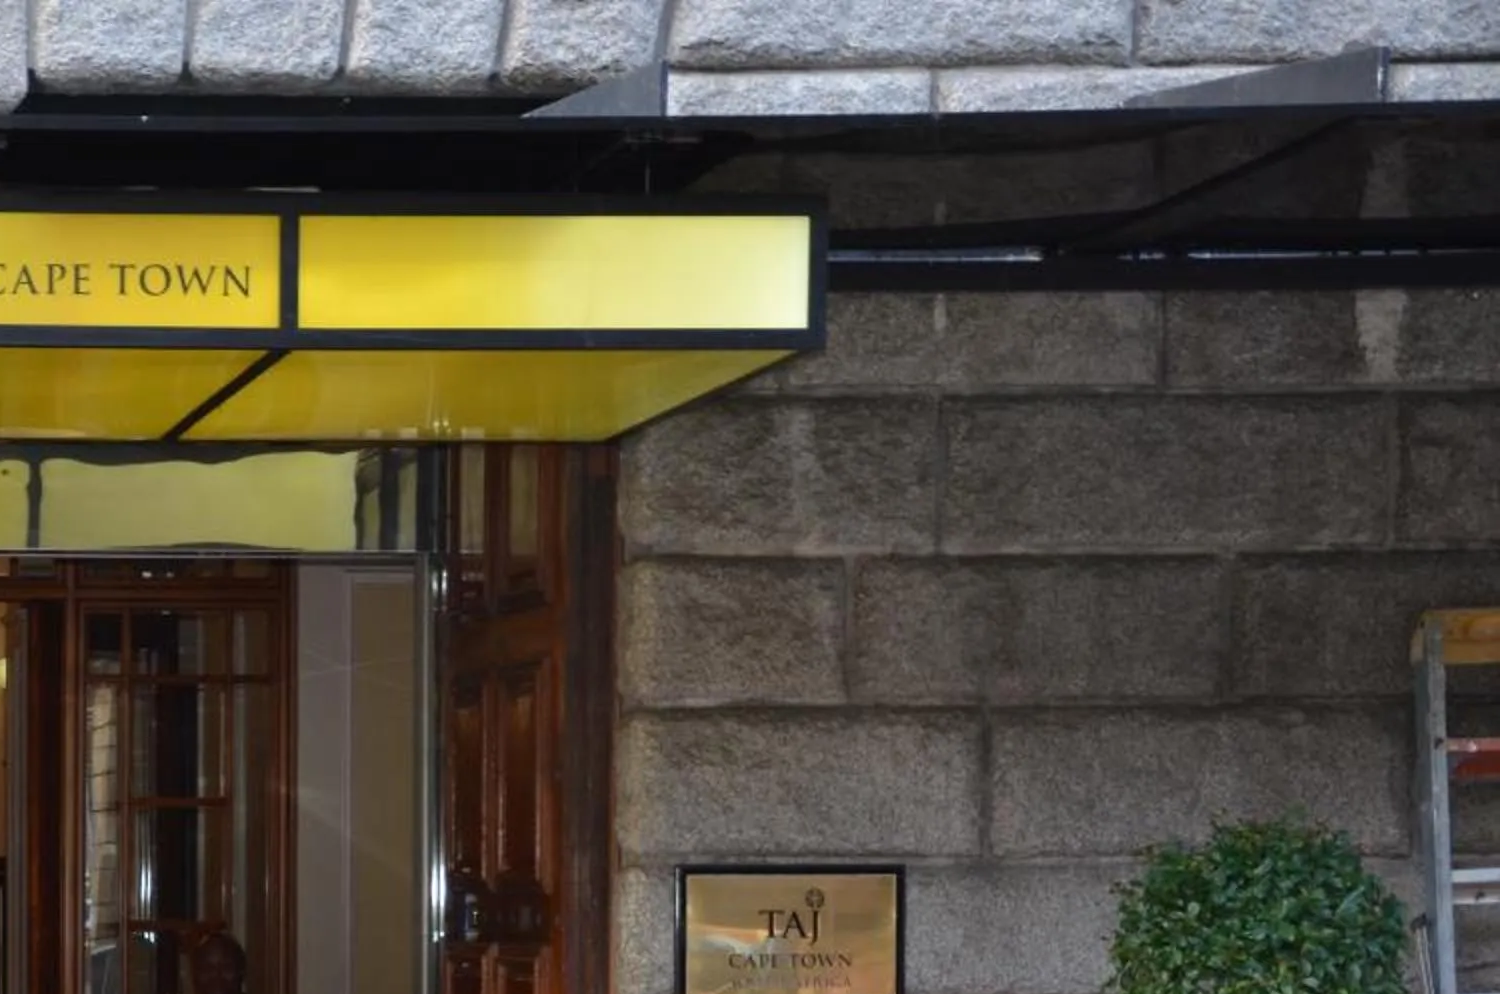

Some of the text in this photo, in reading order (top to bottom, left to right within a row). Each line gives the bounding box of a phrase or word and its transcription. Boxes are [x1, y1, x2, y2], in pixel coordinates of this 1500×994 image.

[110, 264, 252, 298] TOWN
[758, 909, 821, 946] TAJ
[728, 953, 853, 970] CAPE TOWN
